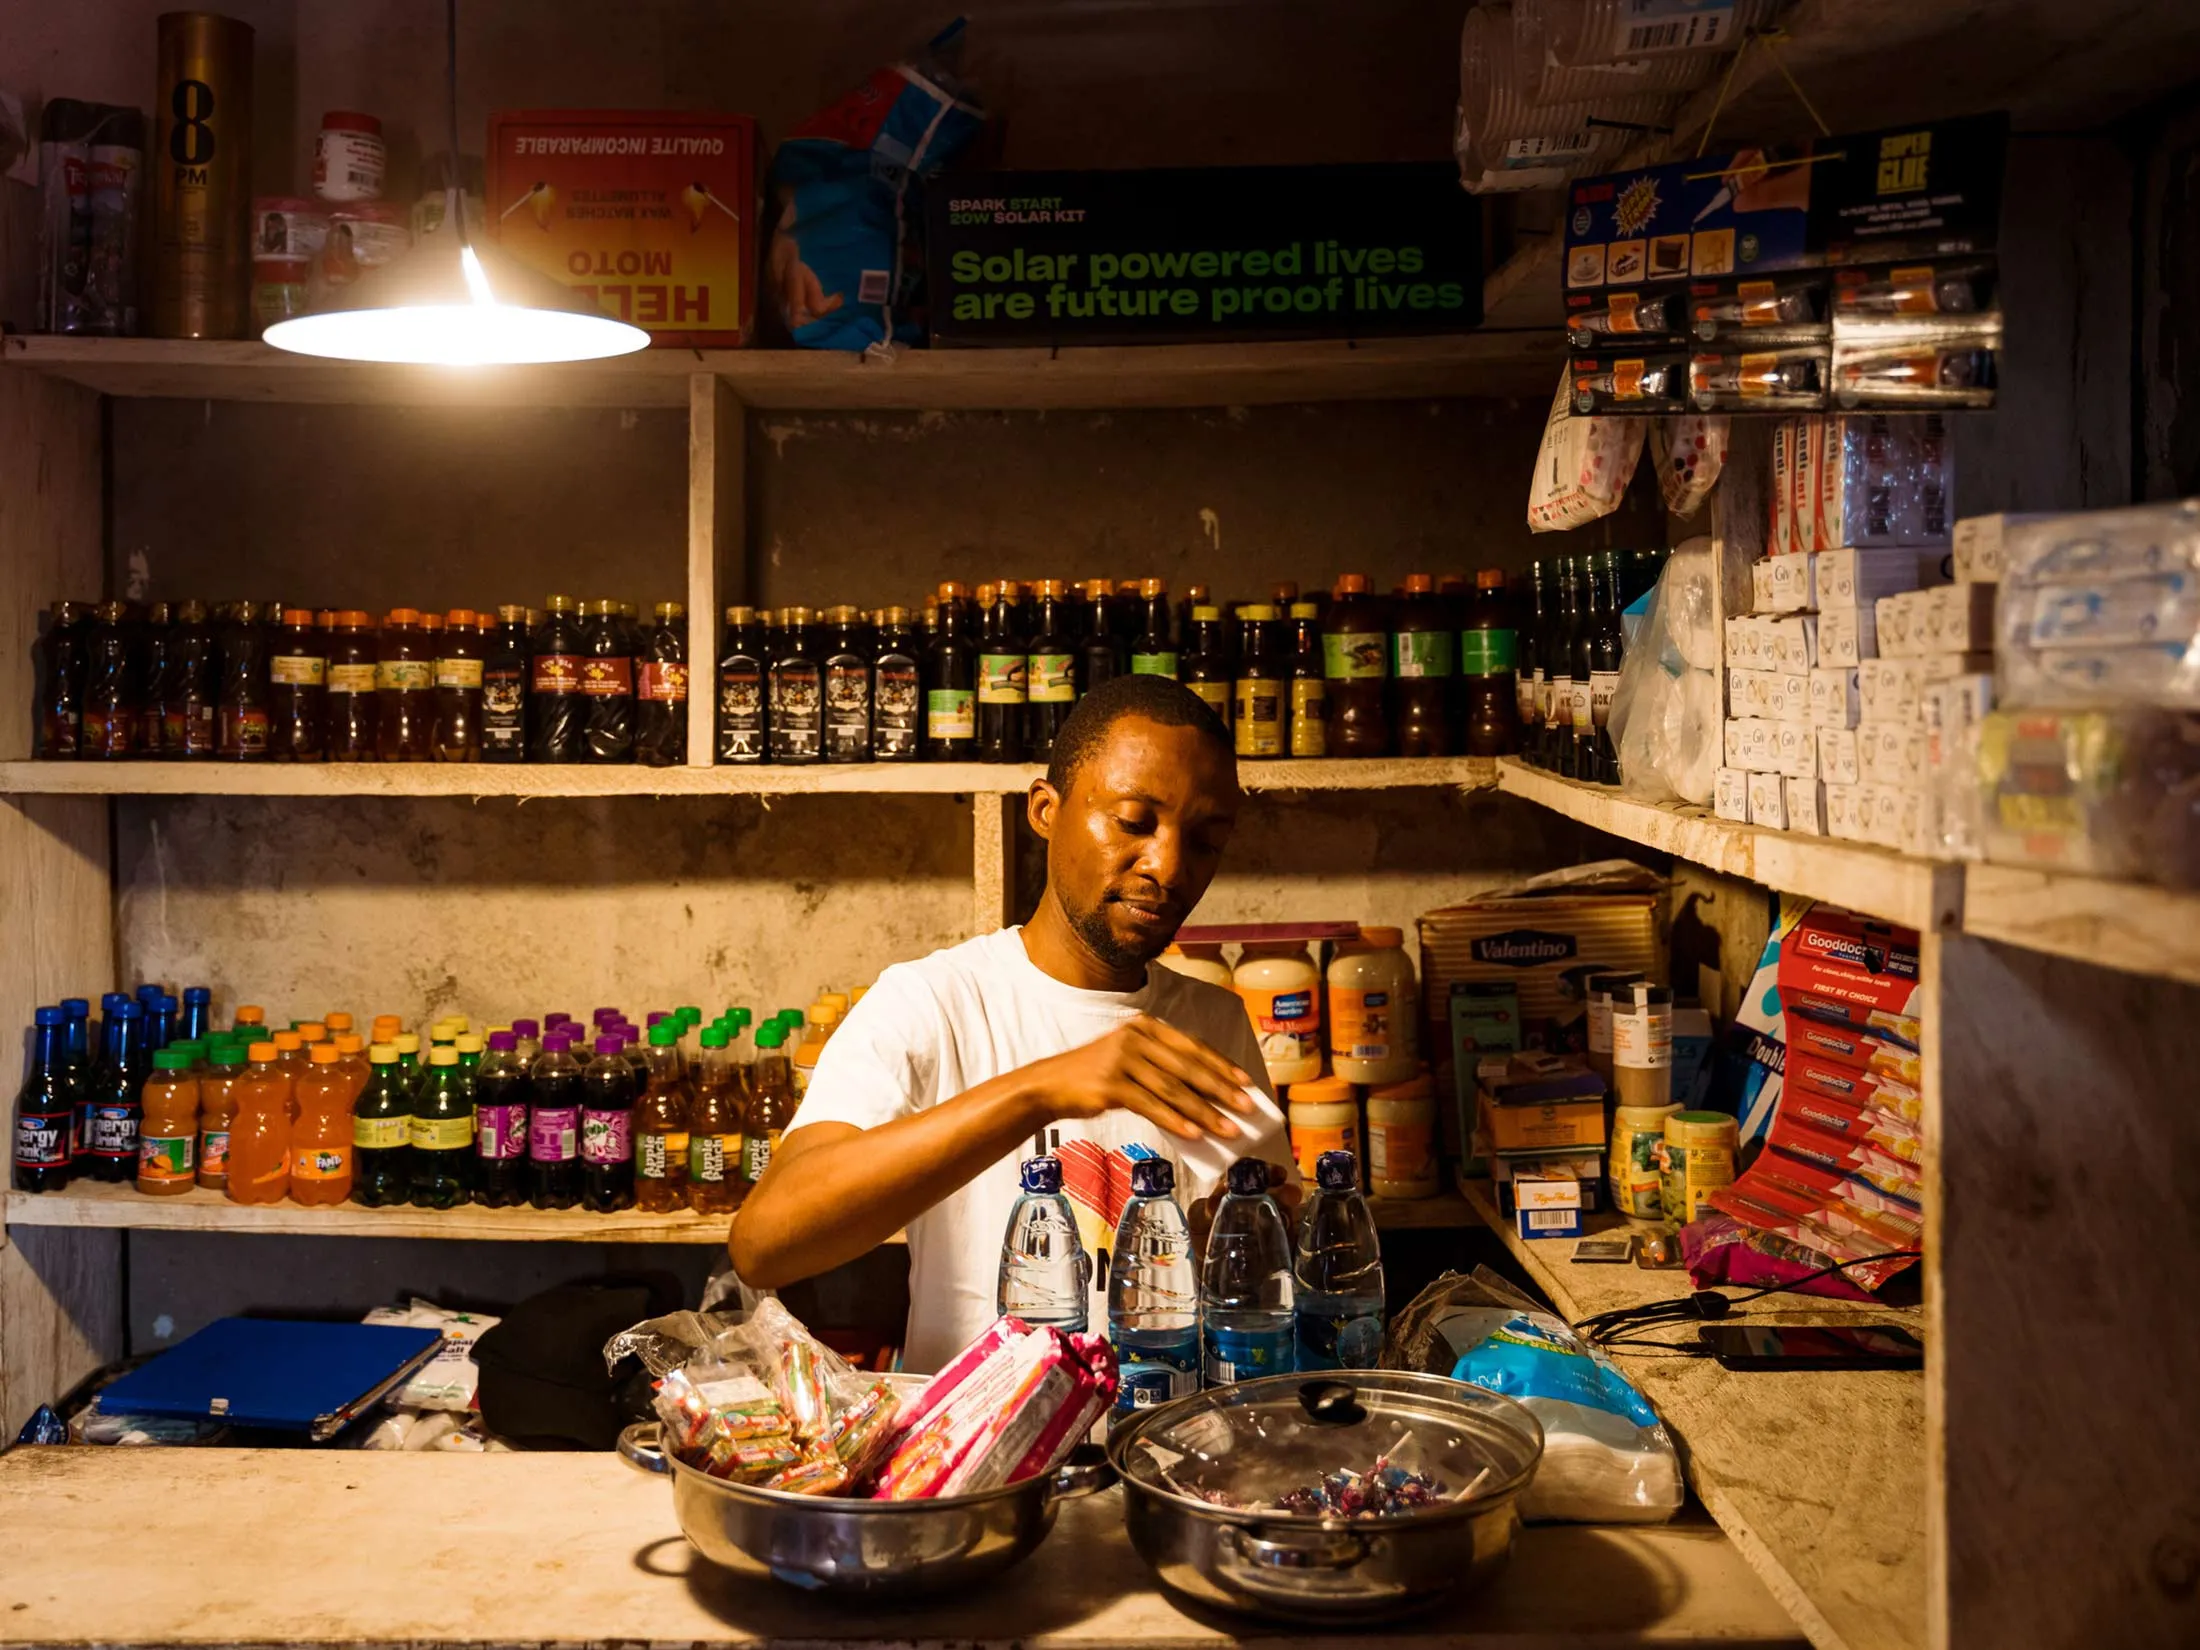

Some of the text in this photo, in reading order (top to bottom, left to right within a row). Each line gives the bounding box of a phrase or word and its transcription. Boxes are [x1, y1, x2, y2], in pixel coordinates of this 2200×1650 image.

[170, 79, 216, 165] 8
[515, 136, 724, 155] QUALITE INCOMPARABLE
[175, 168, 207, 186] PM
[565, 207, 672, 220] WAX MATCHES
[950, 197, 1063, 212] SPARK START
[951, 209, 1086, 225] 20W SOLAR KIT
[568, 251, 672, 276] MOTO
[952, 240, 1425, 287] Solar powered lives
[570, 285, 710, 322] HELL
[953, 277, 1465, 322] are future proof lives
[1480, 939, 1567, 959] Valentino
[1813, 983, 1879, 1004] FIRST MY CHOICE
[1800, 1106, 1847, 1128] Gooddoctor
[643, 1135, 656, 1178] Apple
[654, 1136, 666, 1179] Punch
[701, 1139, 713, 1180] Apple
[711, 1139, 724, 1180] Punch
[748, 1139, 761, 1180] Apple
